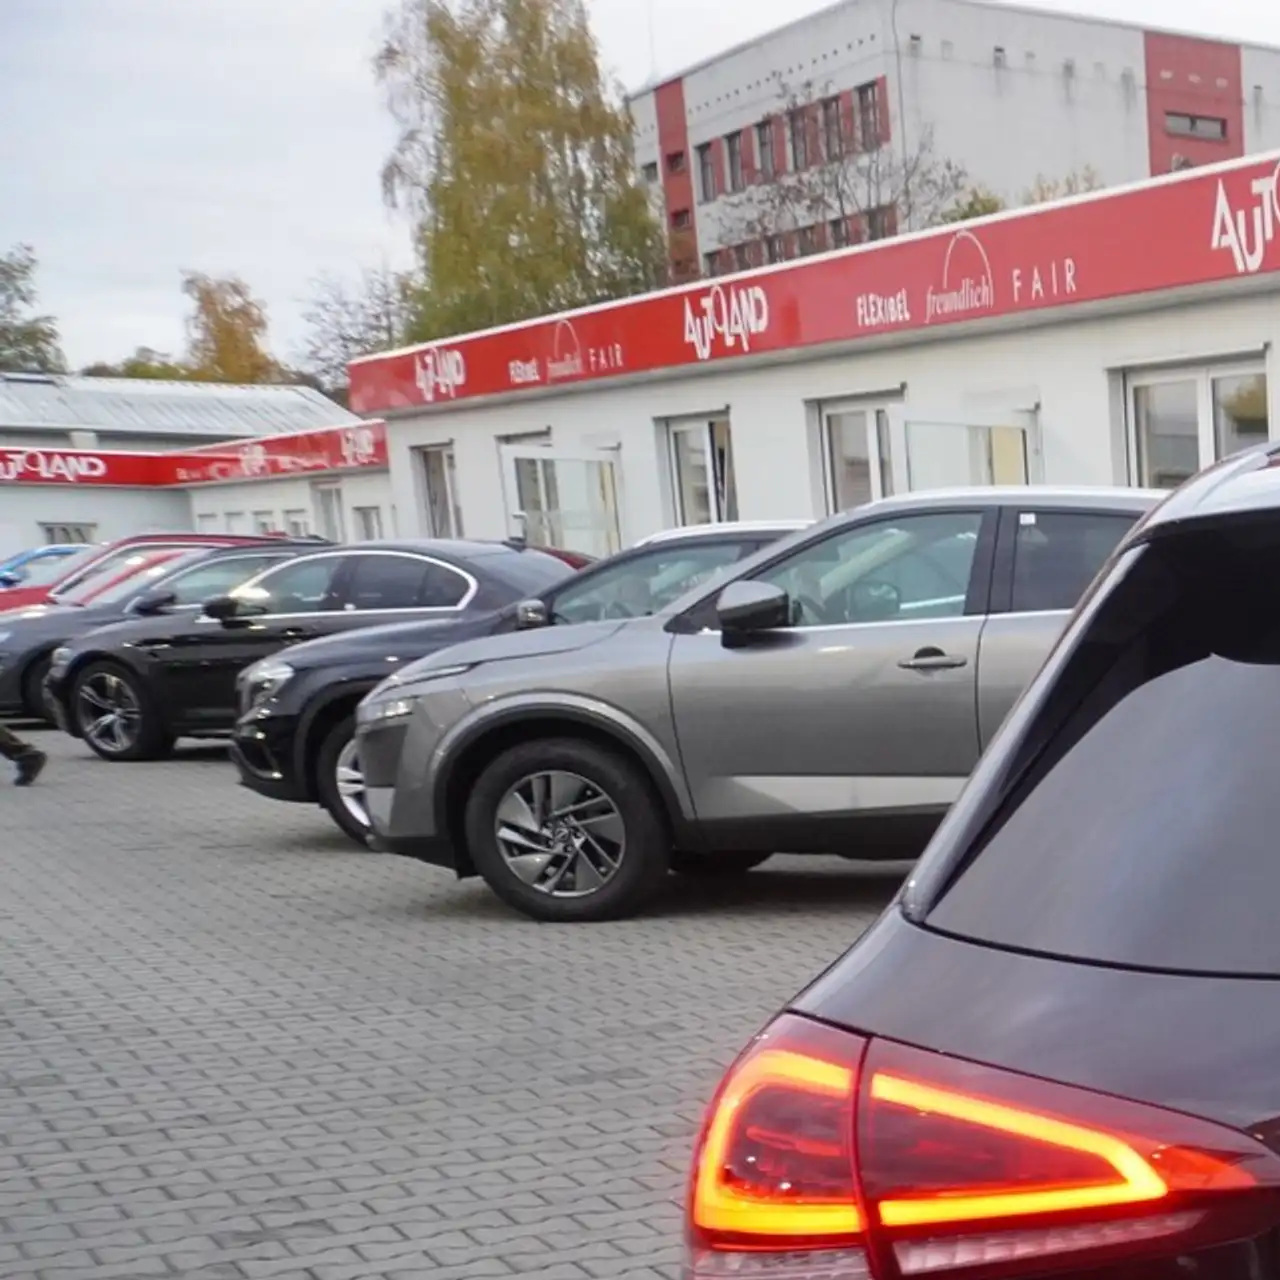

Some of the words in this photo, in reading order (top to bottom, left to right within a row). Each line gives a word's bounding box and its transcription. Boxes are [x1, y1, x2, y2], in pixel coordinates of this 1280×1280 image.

[856, 287, 911, 327] FLEXIBEL
[924, 275, 992, 324] freundlich
[1012, 257, 1077, 303] FAIR
[683, 284, 769, 360] AUTOLAND
[589, 342, 624, 372] FAIR
[0, 450, 107, 482] UTOLAND
